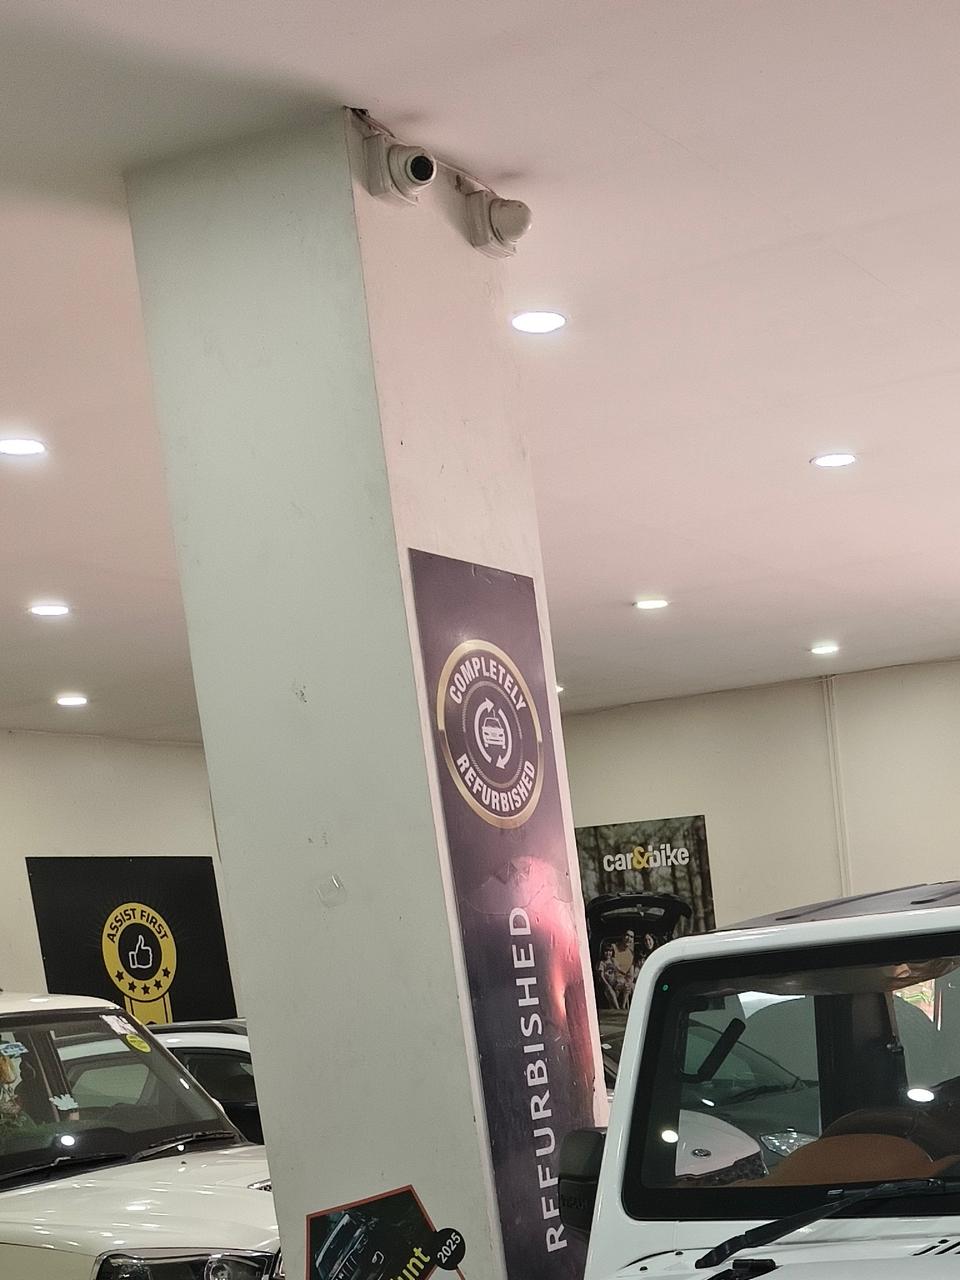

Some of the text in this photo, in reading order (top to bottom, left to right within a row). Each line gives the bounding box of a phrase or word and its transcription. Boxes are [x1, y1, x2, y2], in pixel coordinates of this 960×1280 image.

[449, 657, 527, 711] COMPLETELY
[456, 753, 536, 813] REFURBISHED
[603, 843, 690, 872] car&bike
[106, 908, 169, 944] ASSIST FIRST
[437, 1231, 461, 1264] 2025
